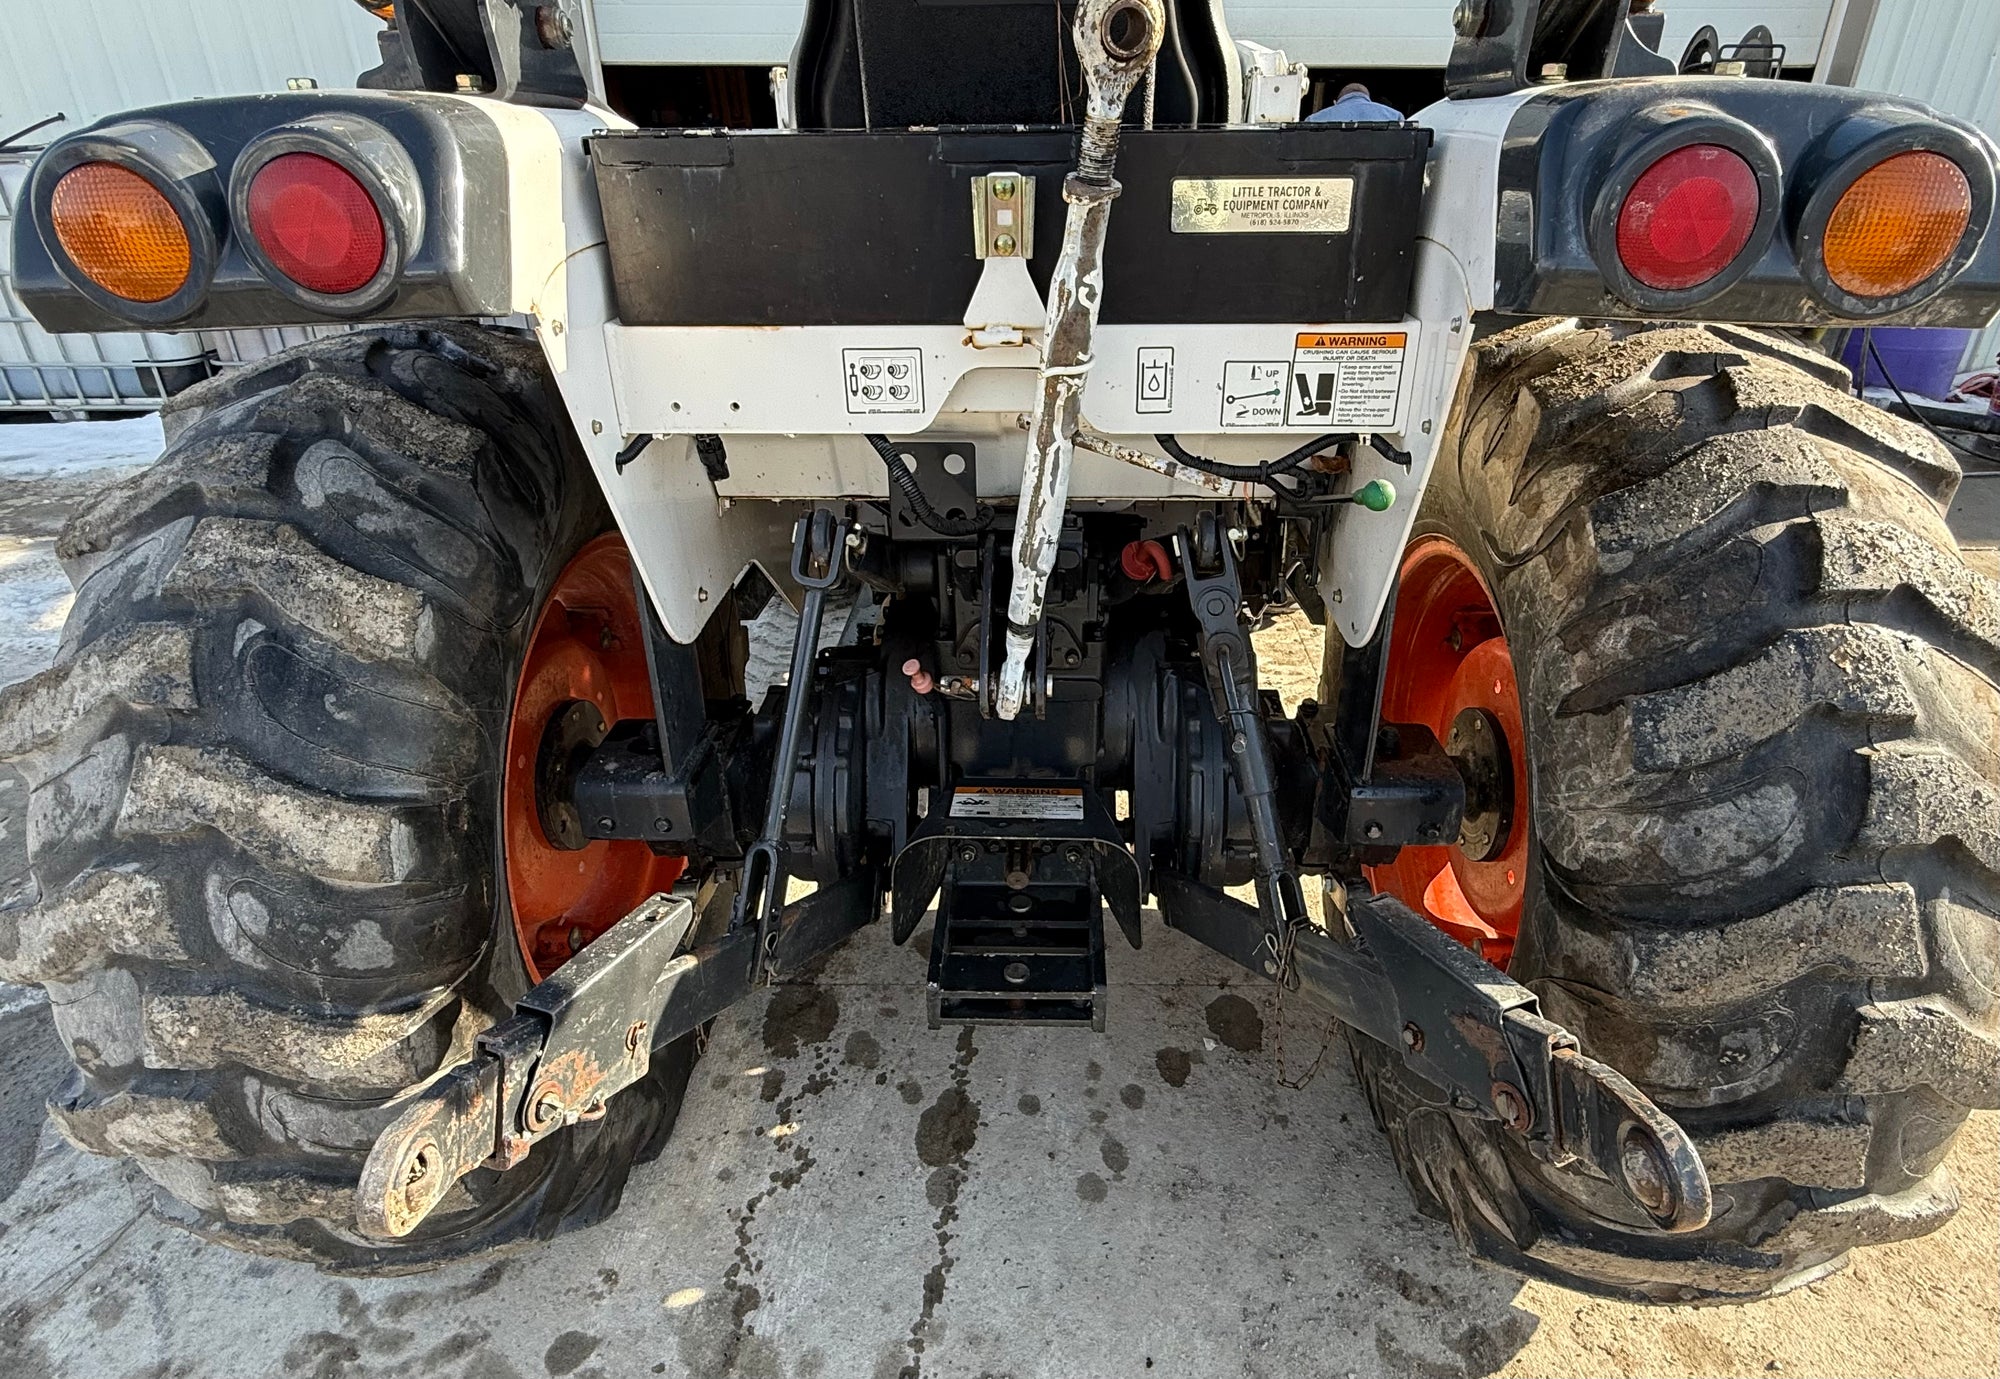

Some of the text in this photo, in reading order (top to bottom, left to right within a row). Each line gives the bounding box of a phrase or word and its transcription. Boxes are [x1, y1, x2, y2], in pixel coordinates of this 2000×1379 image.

[1232, 186, 1322, 197] LITTLE TRACTOR &
[1224, 200, 1330, 213] EQUIPMENT COMPANY
[1329, 336, 1387, 346] WARNING
